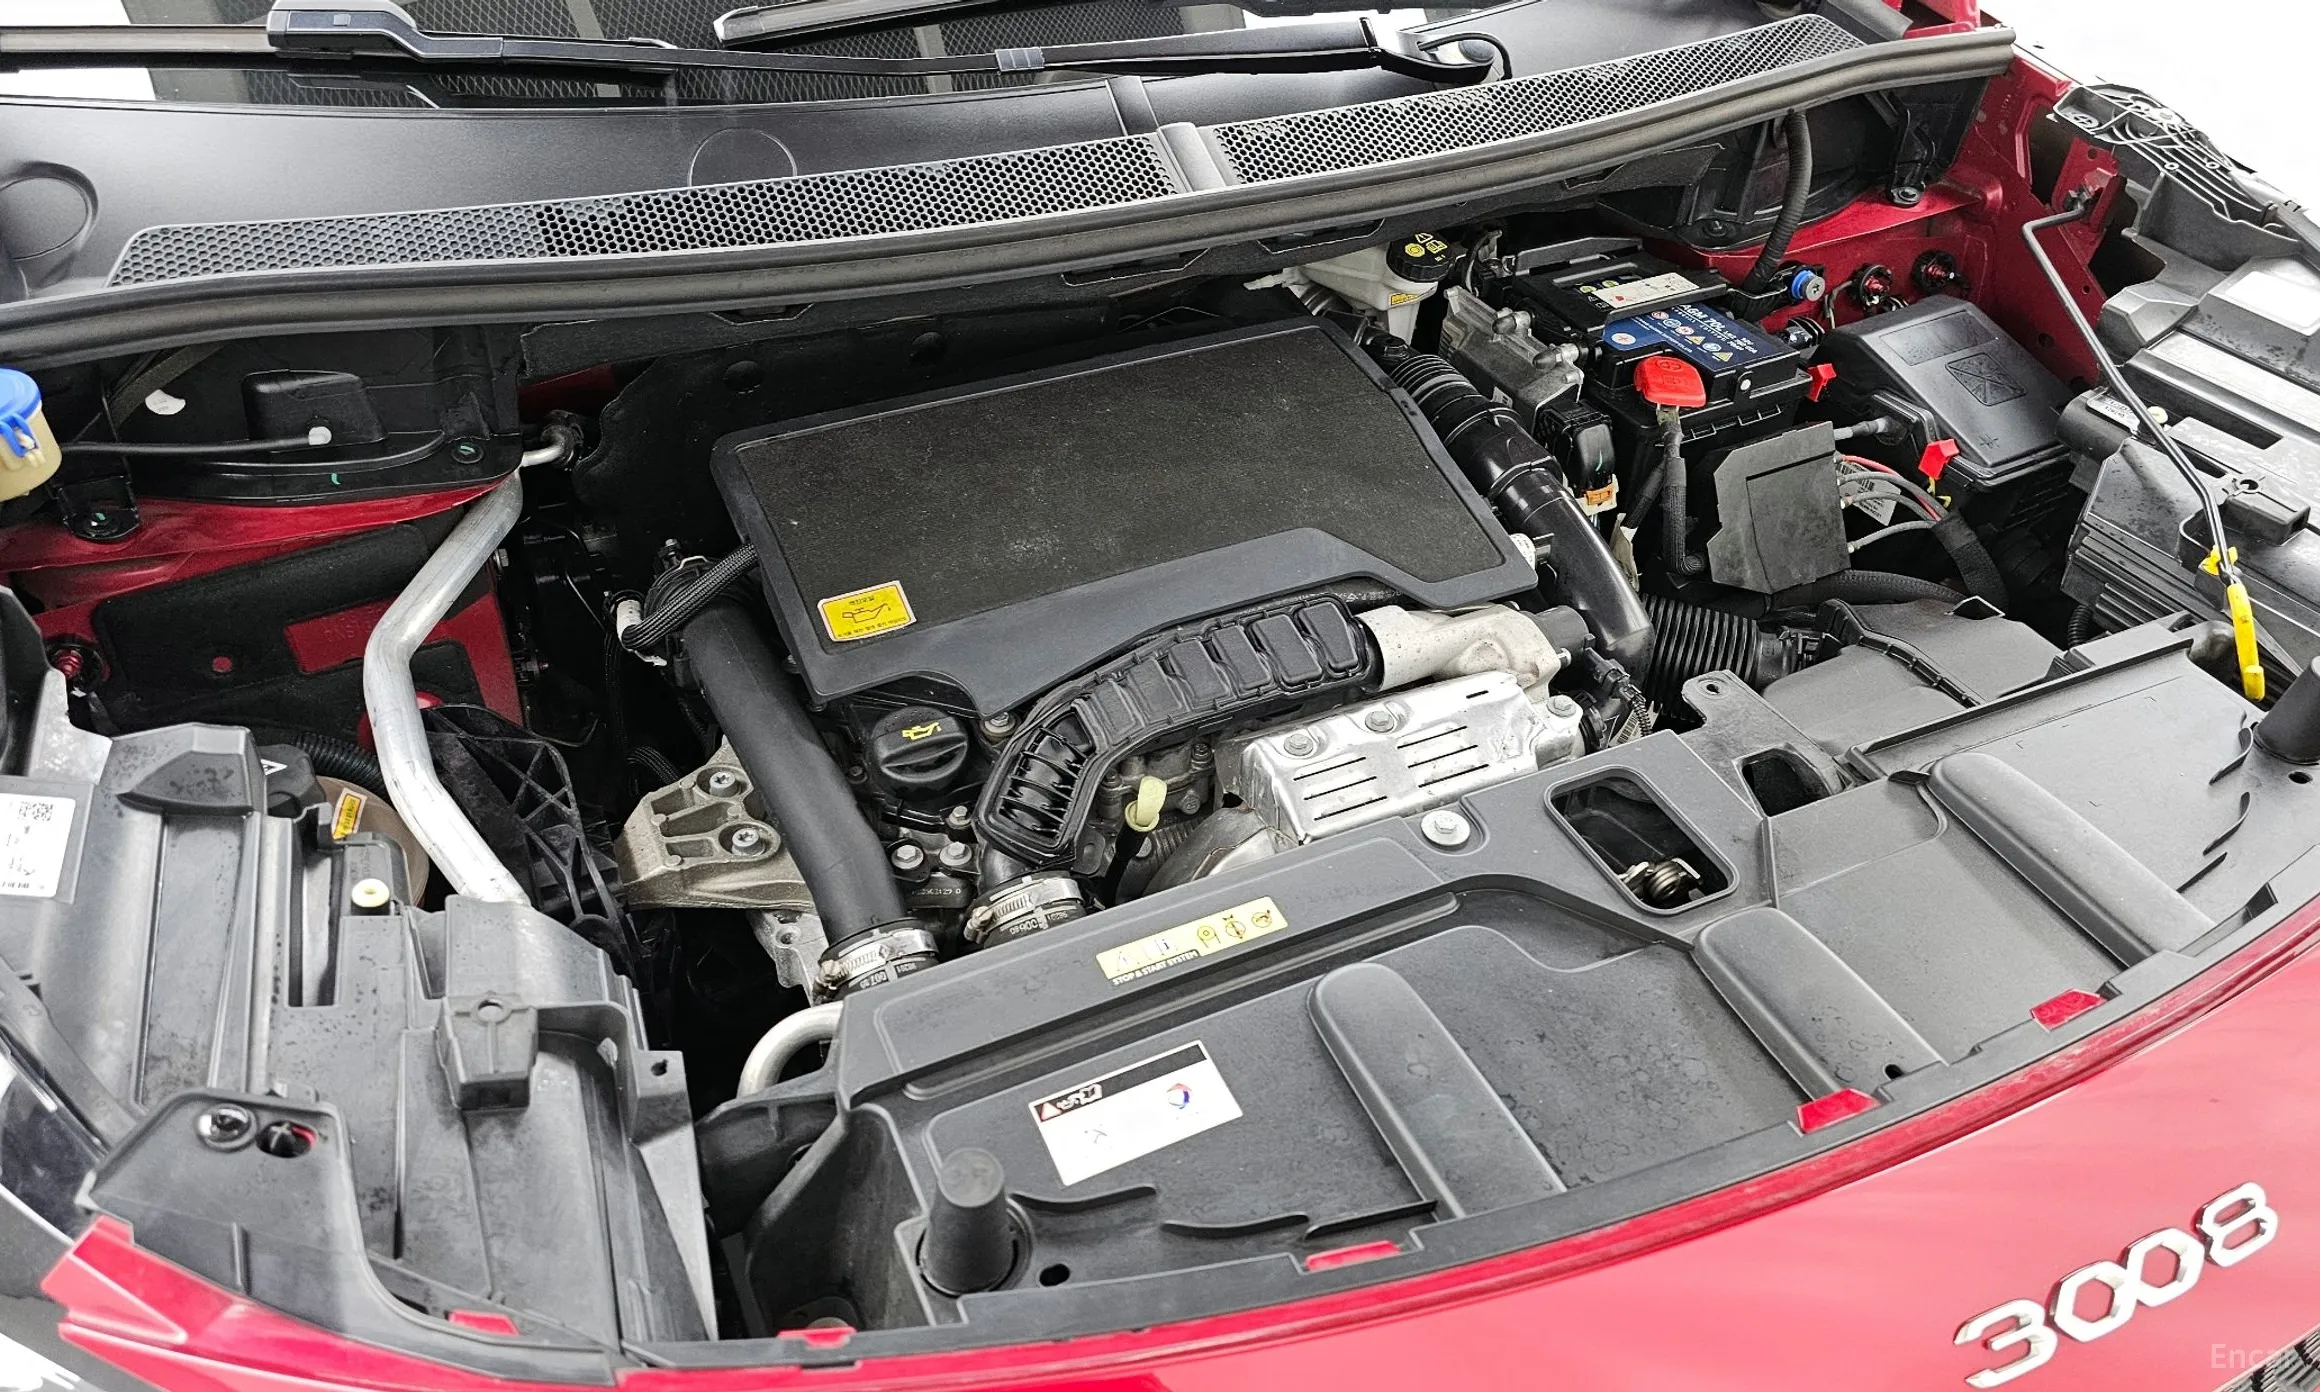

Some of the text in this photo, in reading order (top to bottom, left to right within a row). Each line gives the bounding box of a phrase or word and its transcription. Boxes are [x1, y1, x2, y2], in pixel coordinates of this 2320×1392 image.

[1680, 304, 1708, 319] AGM
[1112, 972, 1135, 985] STOP
[1143, 961, 1167, 975] START
[1167, 950, 1198, 967] SYSTEM
[1953, 1181, 2279, 1389] 3008
